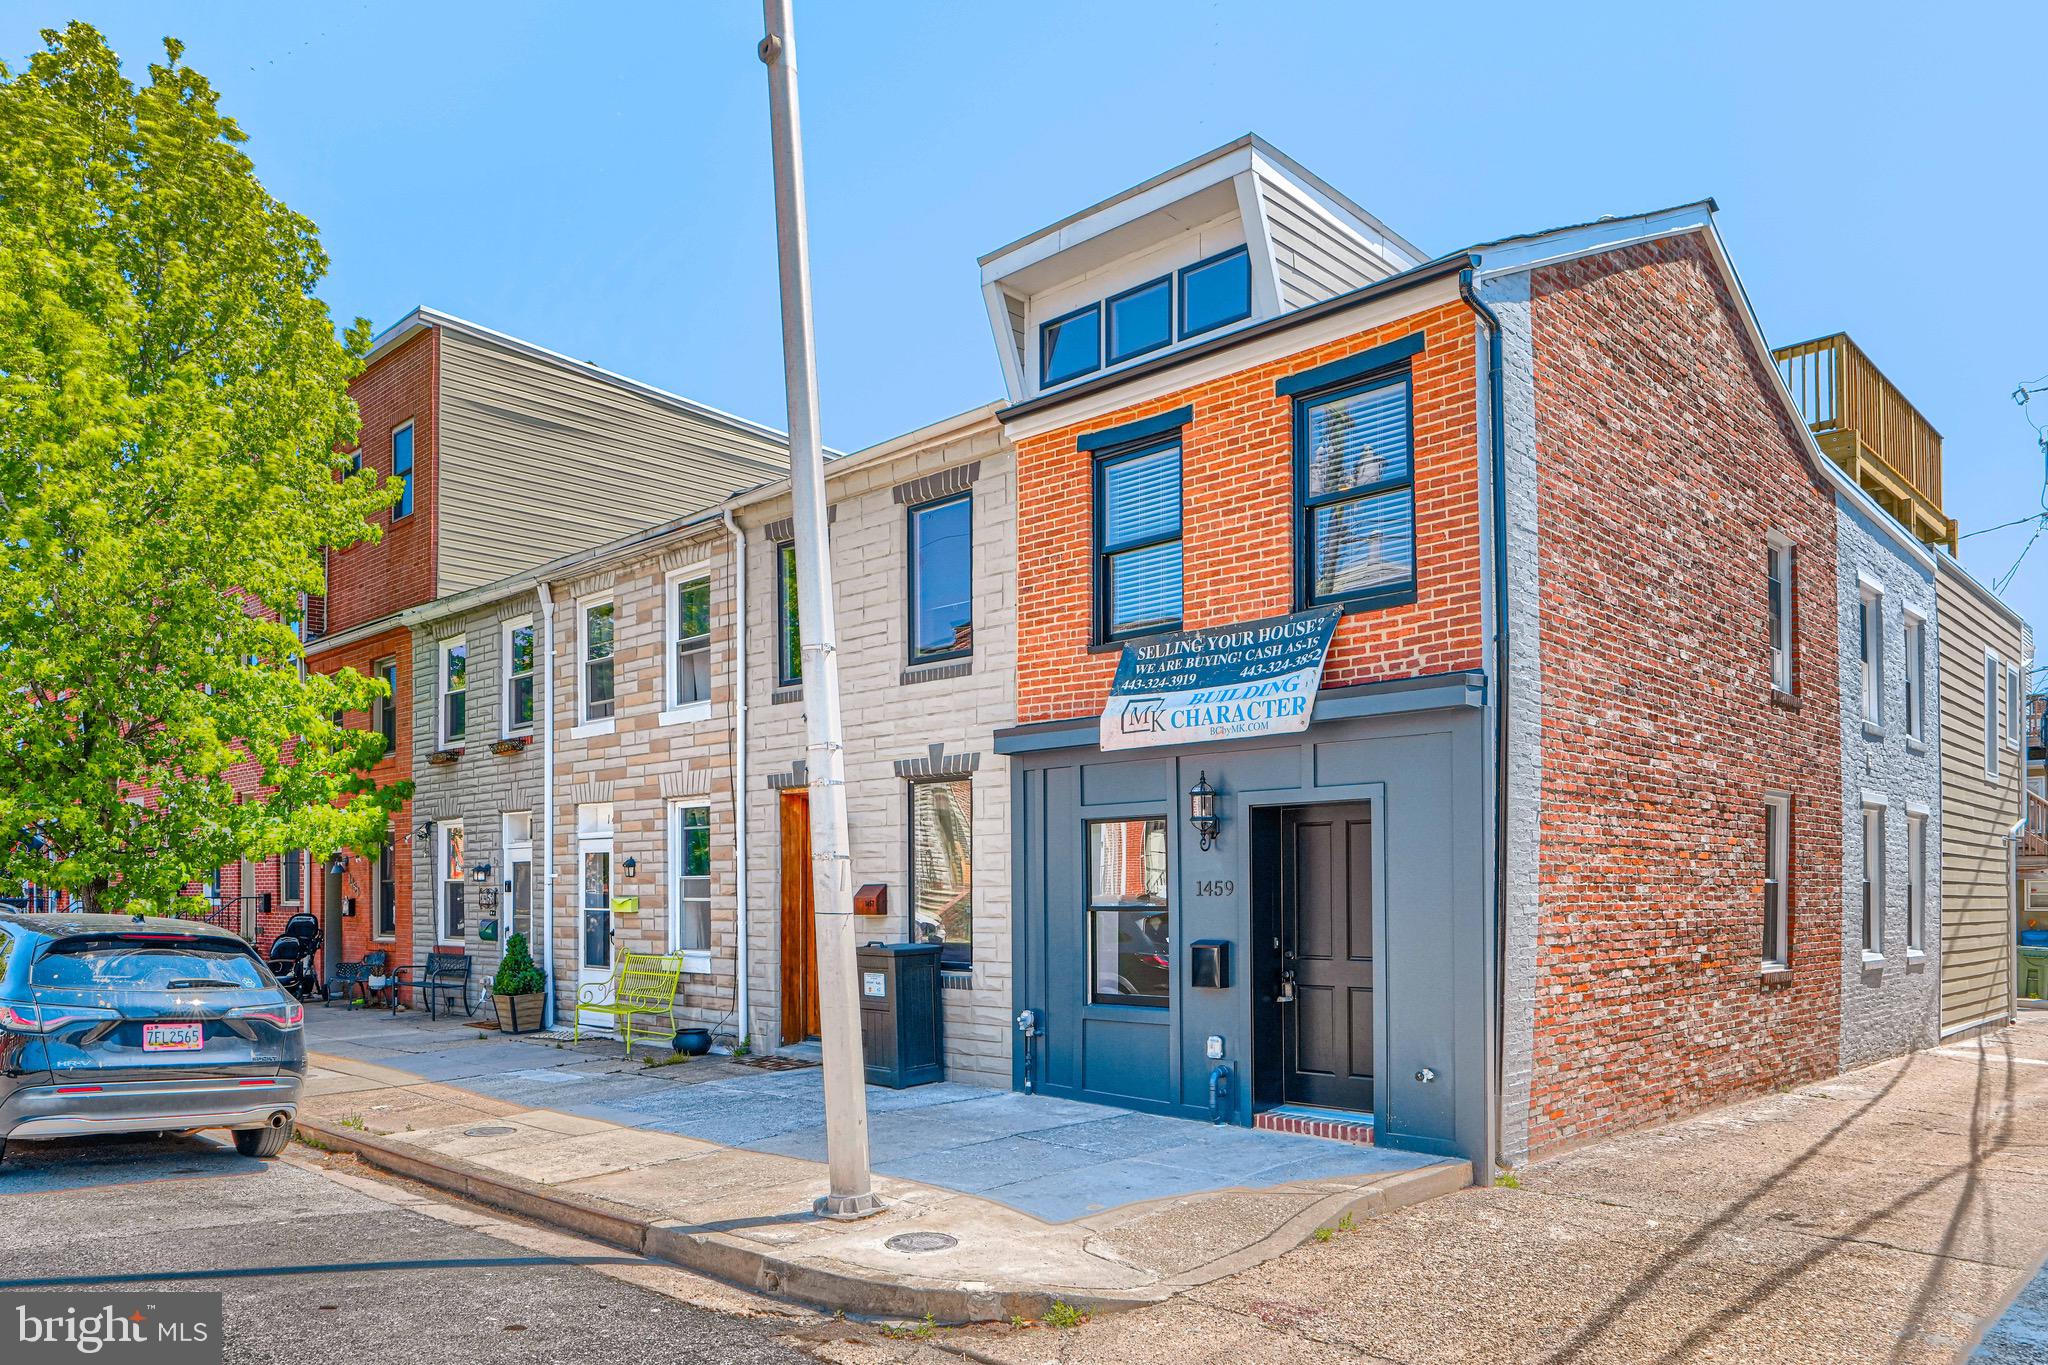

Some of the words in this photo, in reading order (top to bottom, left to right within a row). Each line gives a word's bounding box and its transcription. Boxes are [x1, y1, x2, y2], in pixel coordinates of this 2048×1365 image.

[1137, 638, 1204, 661] SELLING
[1206, 632, 1254, 651] YOUR
[1258, 617, 1325, 643] HOUSE?
[1136, 663, 1156, 675] WE
[1157, 658, 1184, 673] ARE
[1184, 651, 1242, 669] BUYING!
[1245, 644, 1283, 661] CASH
[1283, 636, 1321, 655] AS-IS
[1239, 648, 1322, 678] 443-324-3852
[1121, 673, 1197, 690] 443-324-3919
[1187, 675, 1300, 705] BUILDING
[1170, 696, 1307, 729] CHARACTER
[1210, 721, 1269, 735] BCbyMK.COM
[1196, 880, 1234, 897] 1459
